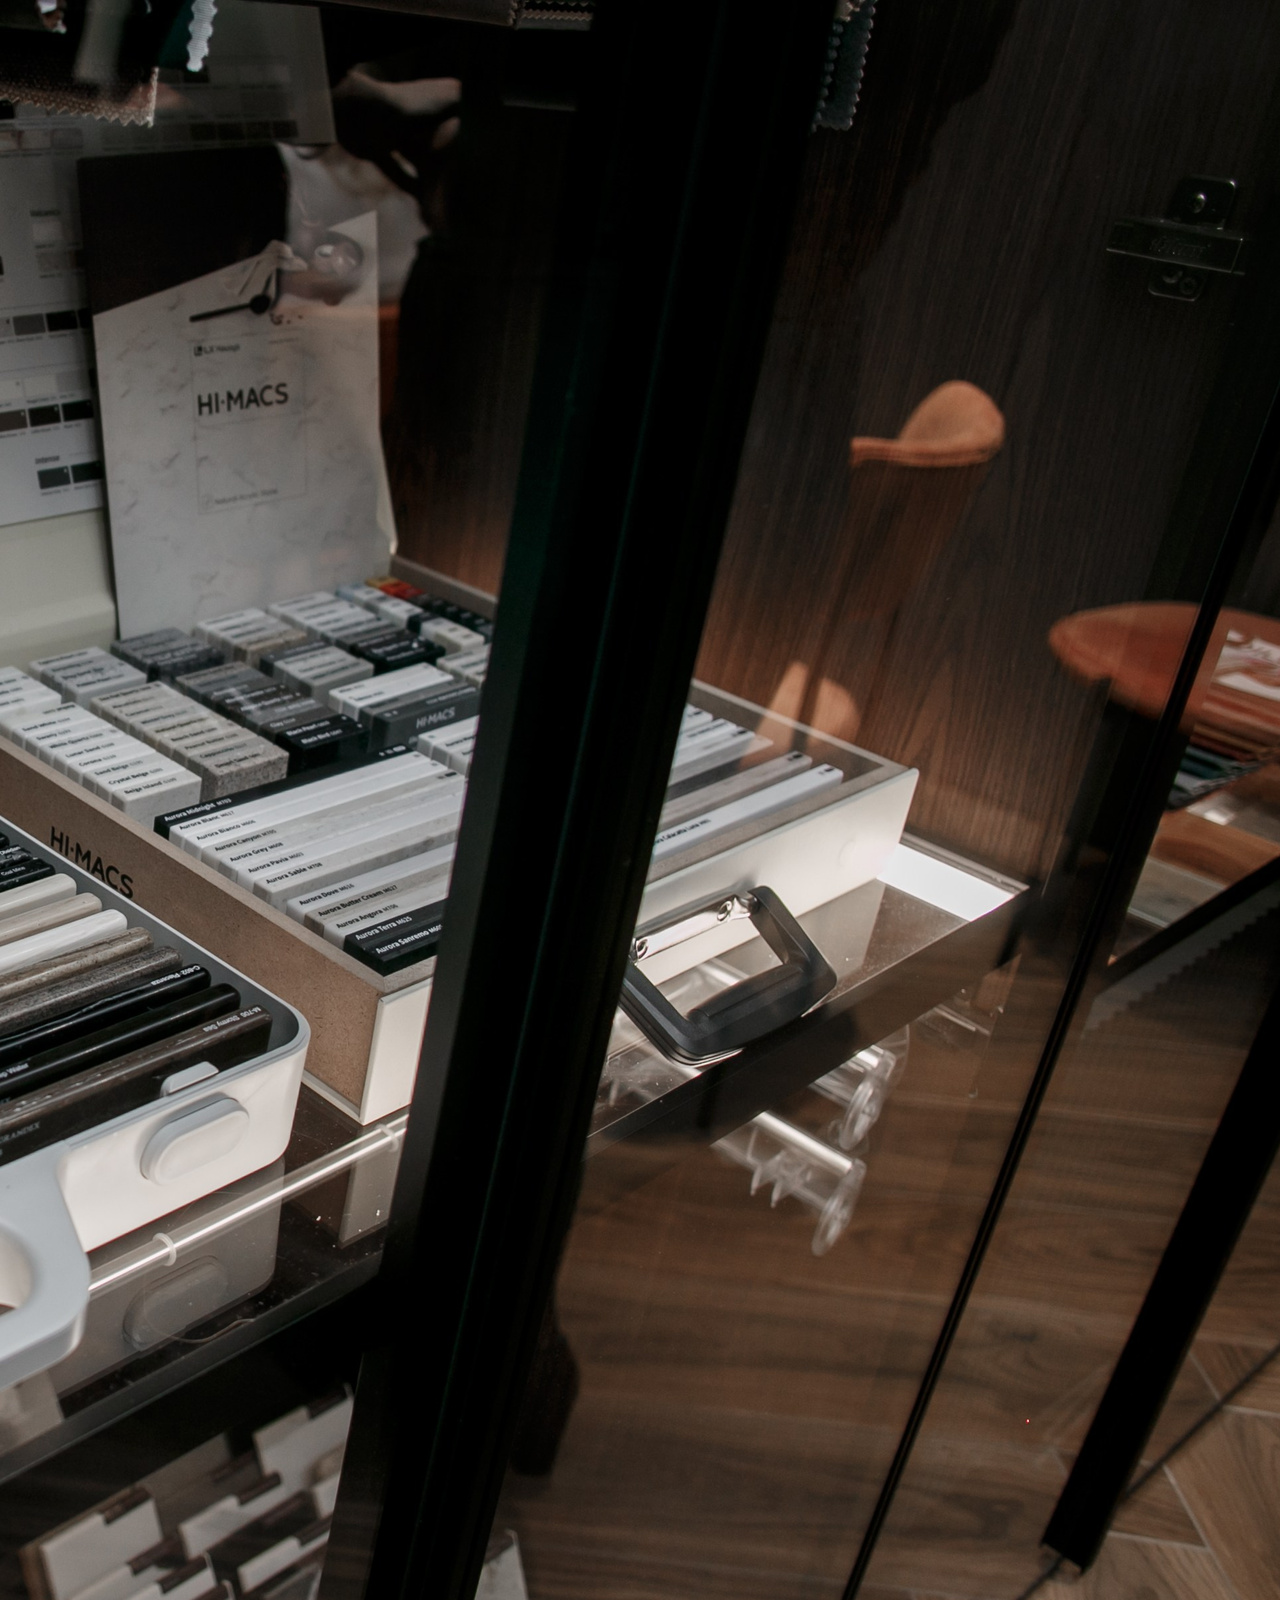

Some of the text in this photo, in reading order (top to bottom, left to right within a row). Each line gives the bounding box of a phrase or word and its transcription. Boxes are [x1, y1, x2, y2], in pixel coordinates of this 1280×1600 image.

[95, 767, 111, 776] Sand
[108, 770, 149, 786] Crystal Beige
[124, 779, 162, 796] Beige Island
[164, 801, 215, 822] Aurora Midnight
[179, 813, 220, 831] Aurora Blanc
[196, 830, 218, 841] Aurora
[214, 833, 261, 852] Aurora Canyon
[230, 845, 269, 862] Aurora Grey
[248, 856, 289, 873] Aurora Pavia
[266, 865, 307, 884] Aurora Sable
[299, 887, 339, 906] Aurora Dove
[318, 903, 341, 917] Aurora
[341, 896, 361, 909] Butter
[361, 889, 383, 901] Cream
[336, 908, 383, 929] Aurora Angora
[355, 920, 397, 941] Aurora Terra
[376, 928, 429, 955] Aurora Sanremo
[7, 1060, 29, 1075] Water
